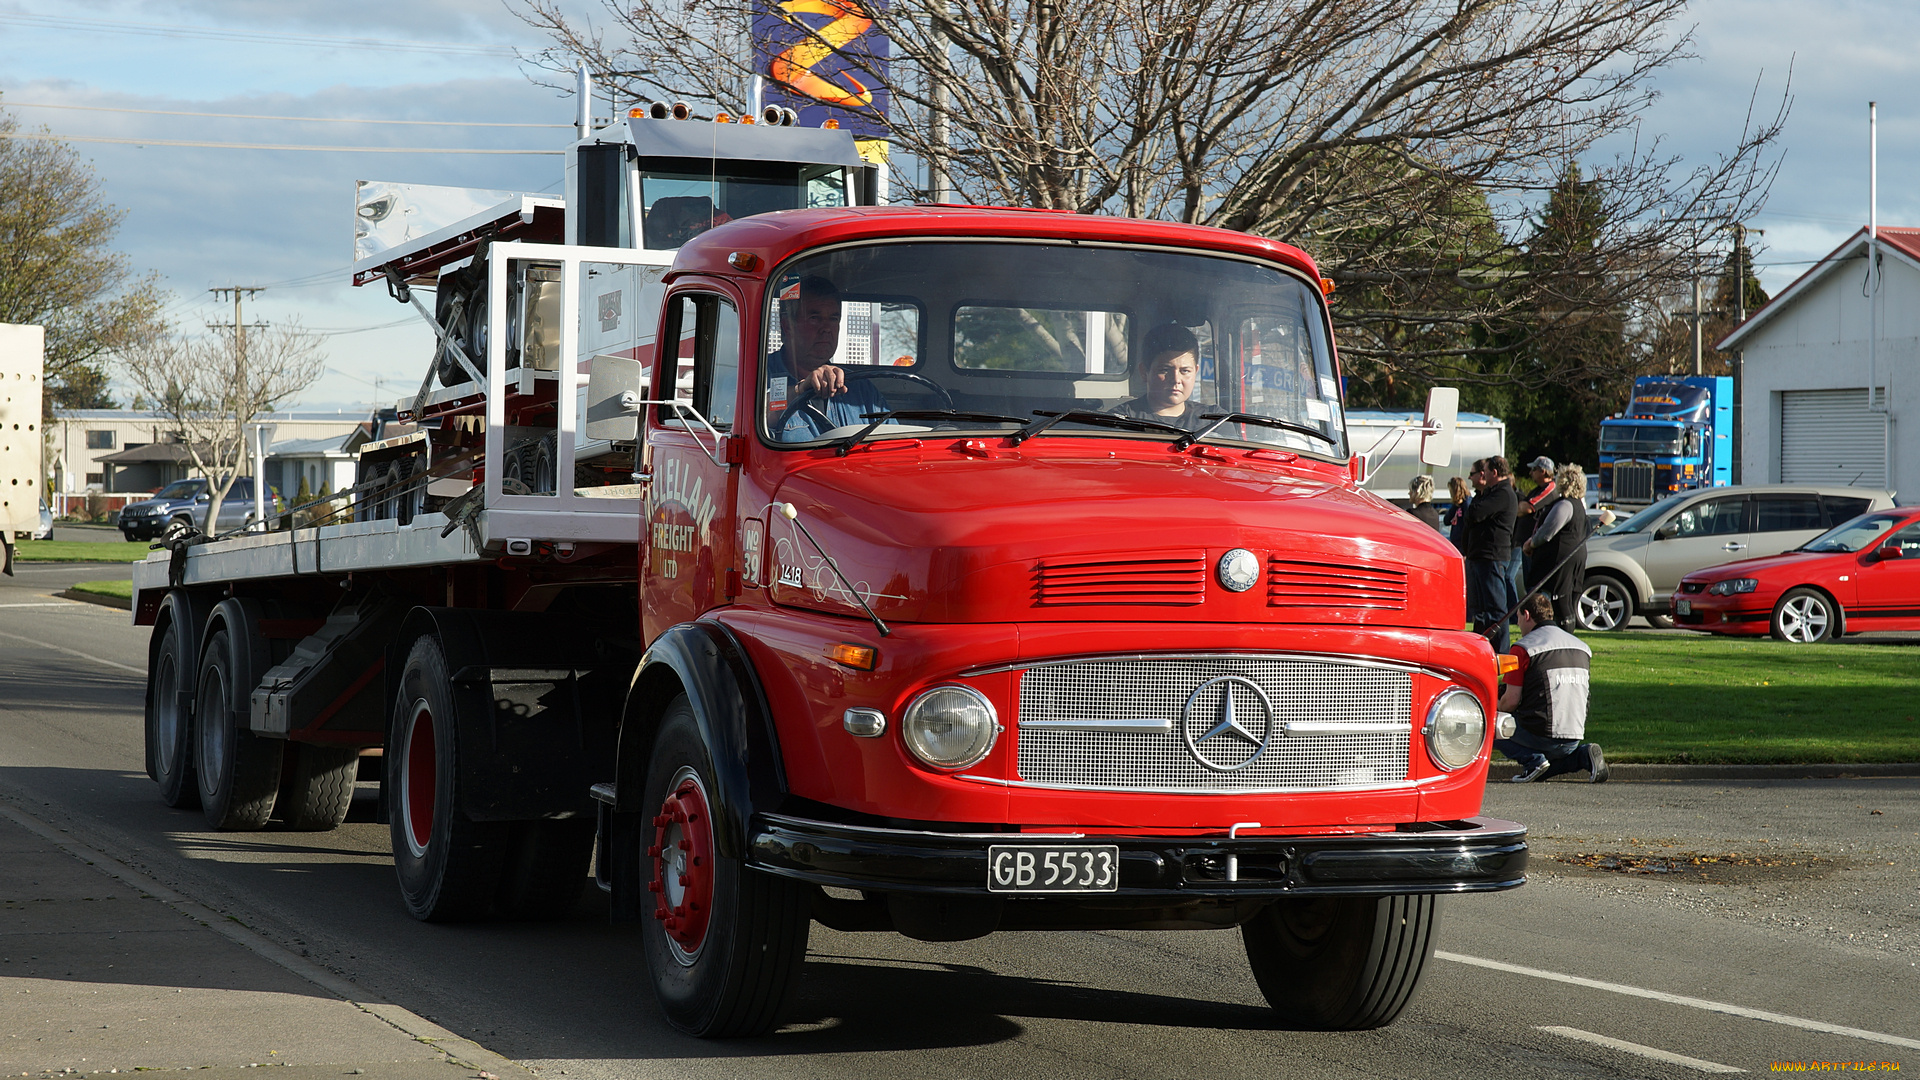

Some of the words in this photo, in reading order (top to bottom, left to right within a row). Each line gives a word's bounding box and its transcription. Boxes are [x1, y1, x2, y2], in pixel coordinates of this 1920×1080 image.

[652, 522, 695, 552] FREIGHT
[664, 559, 679, 579] LTD
[742, 553, 760, 582] 39
[781, 564, 802, 584] 1418
[1556, 674, 1580, 685] Mobil
[994, 851, 1036, 886] GB
[1043, 851, 1113, 886] 5533
